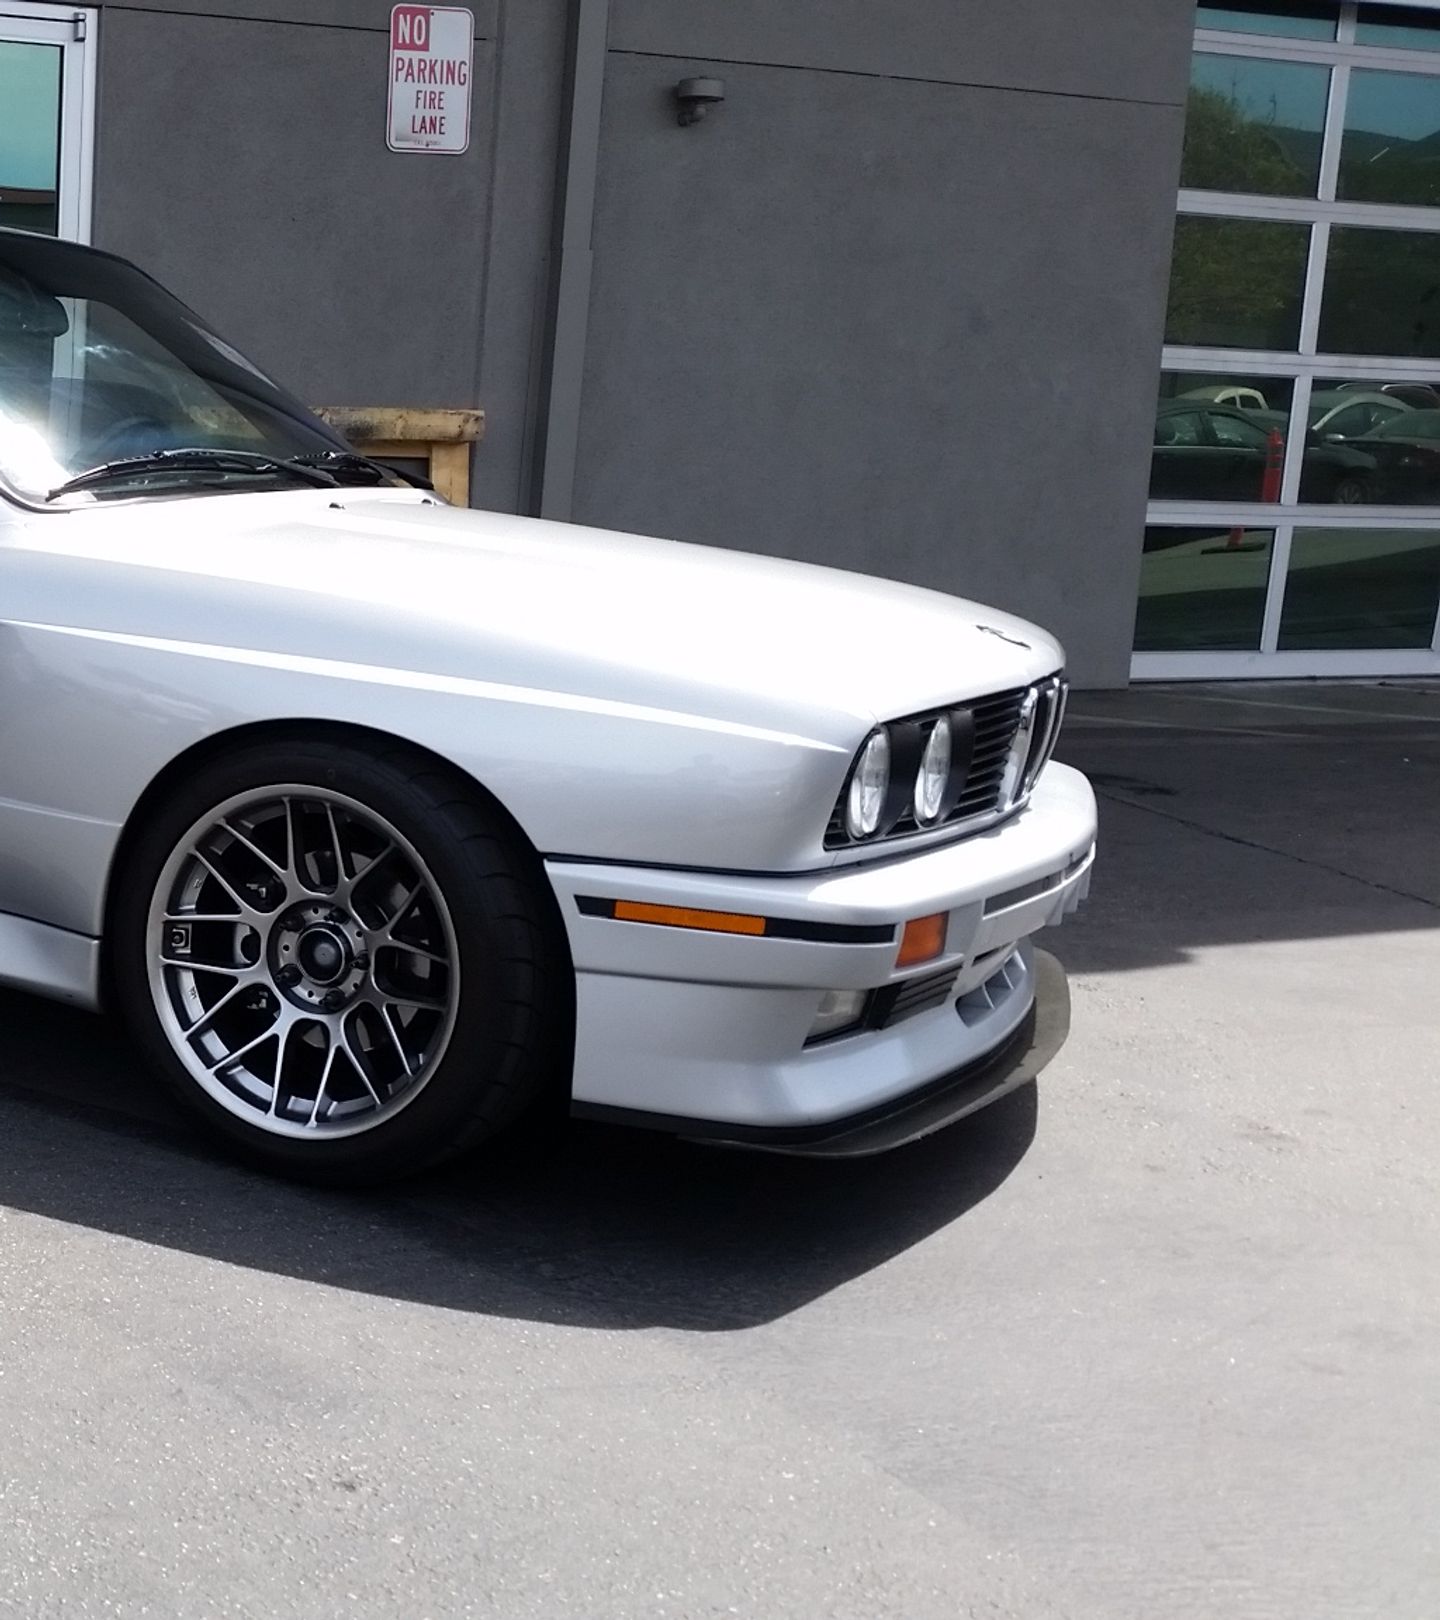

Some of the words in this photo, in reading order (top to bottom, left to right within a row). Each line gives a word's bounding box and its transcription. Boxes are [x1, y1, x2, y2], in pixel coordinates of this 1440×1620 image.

[398, 14, 426, 45] NO
[395, 57, 468, 86] PARKING
[415, 90, 445, 110] FIRE
[412, 115, 446, 135] LANE
